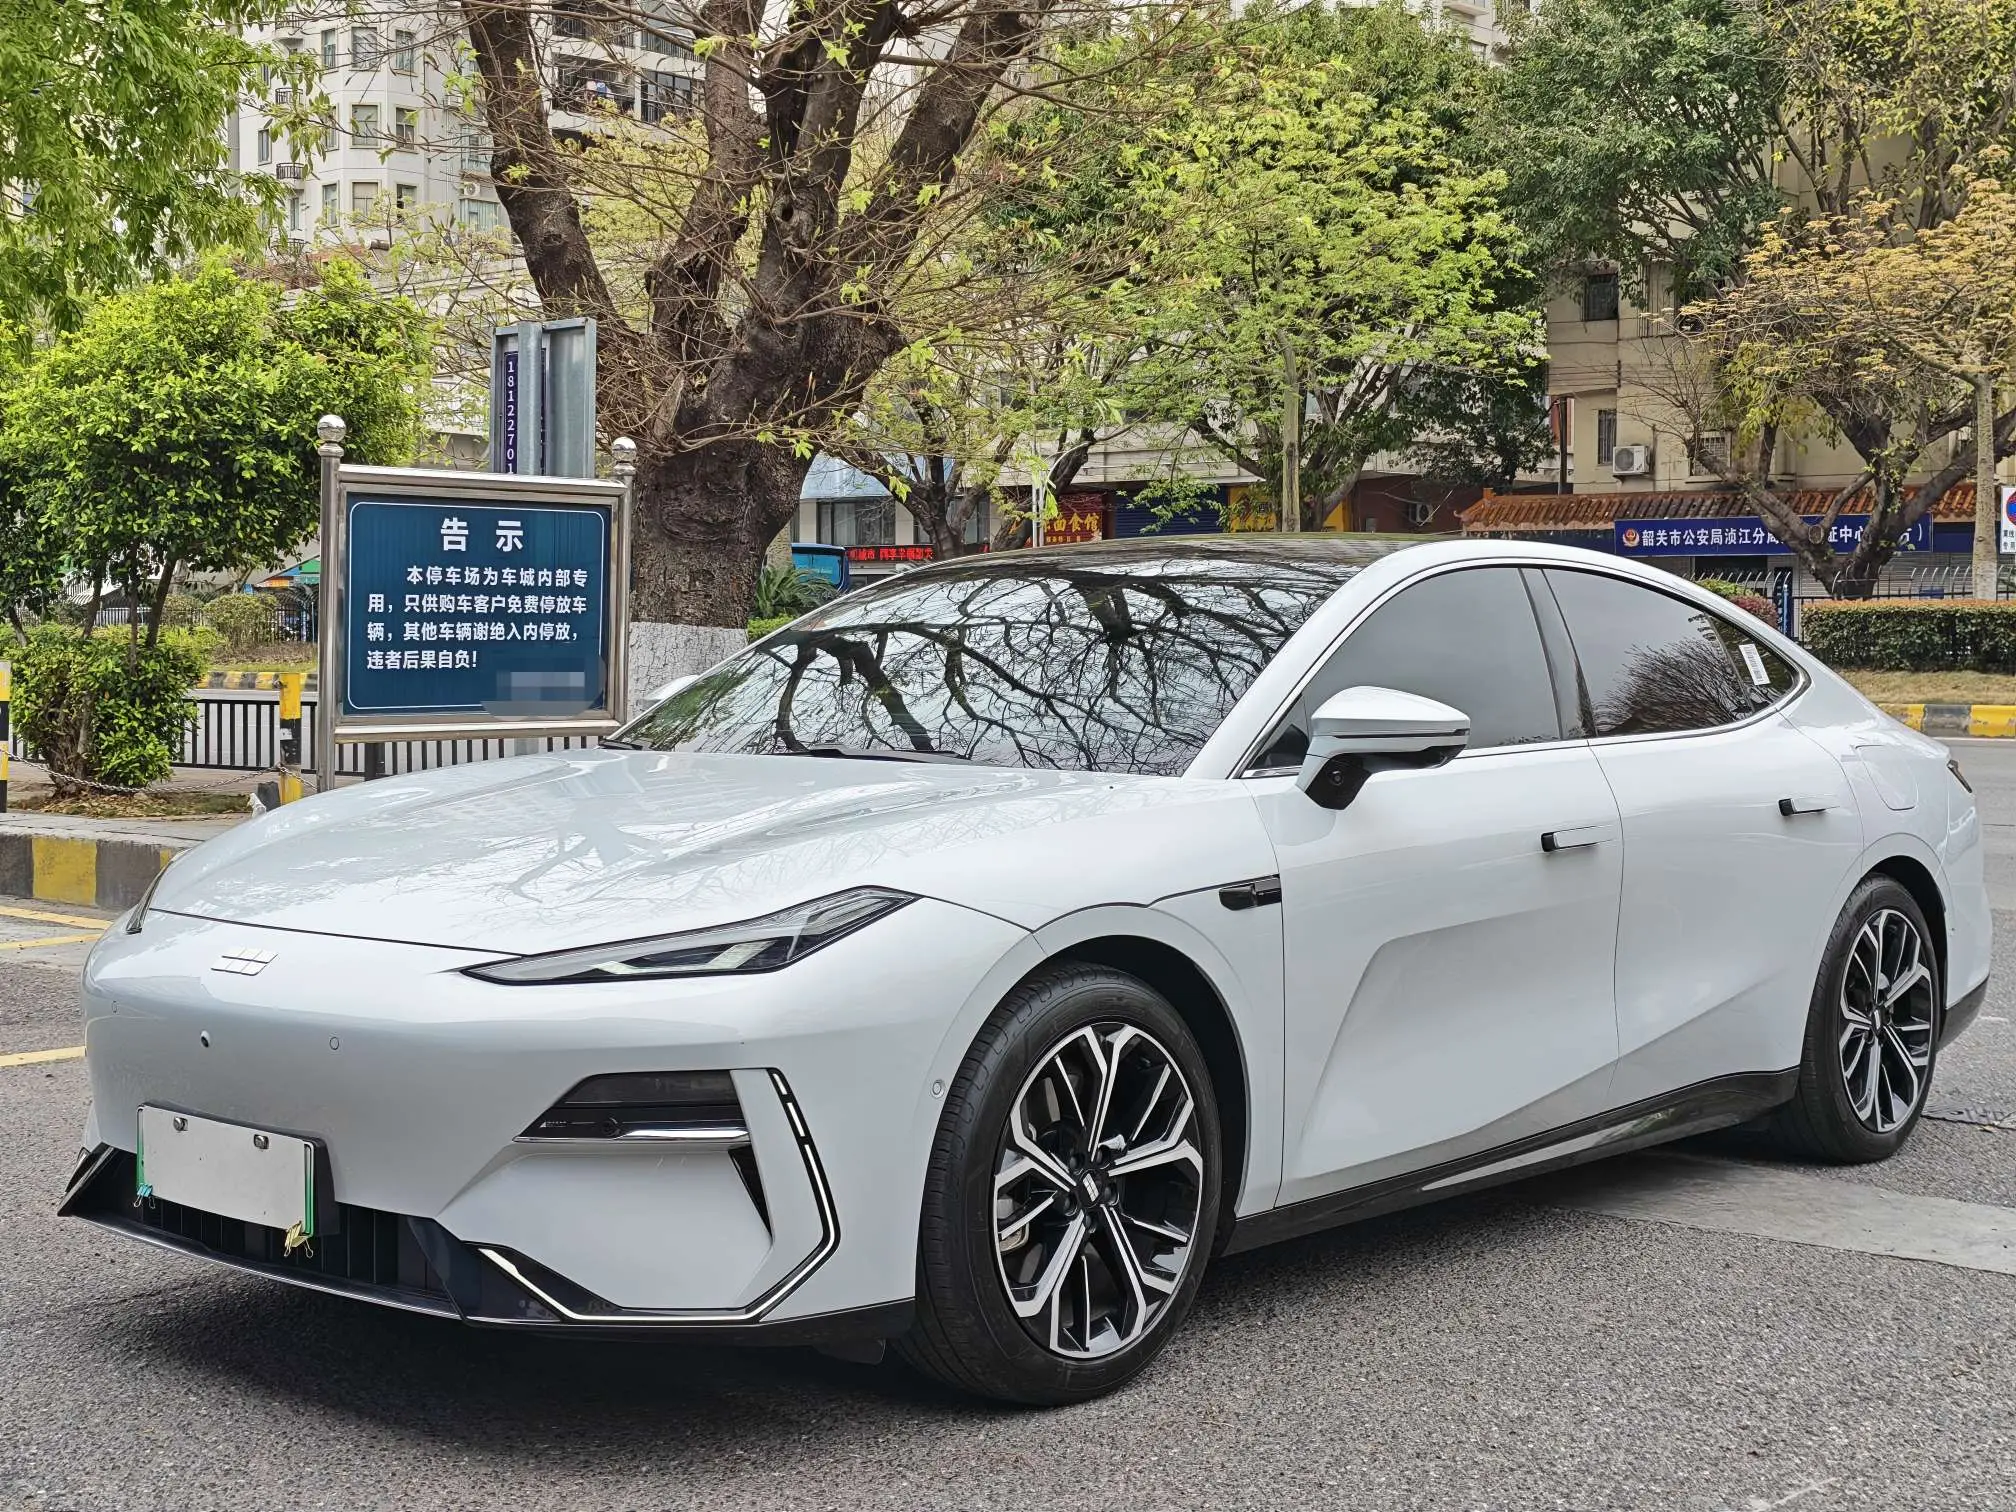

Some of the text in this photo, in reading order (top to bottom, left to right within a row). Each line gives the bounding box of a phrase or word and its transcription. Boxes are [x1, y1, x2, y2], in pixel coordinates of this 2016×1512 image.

[440, 517, 524, 552] 告示
[406, 565, 588, 588] 本停车场为车城内部专
[367, 593, 587, 614] 用，只供购车客户免费停放车
[367, 622, 578, 642] 辆，其他车辆谢绝入内停放，
[366, 650, 477, 670] 违者后果自负！
